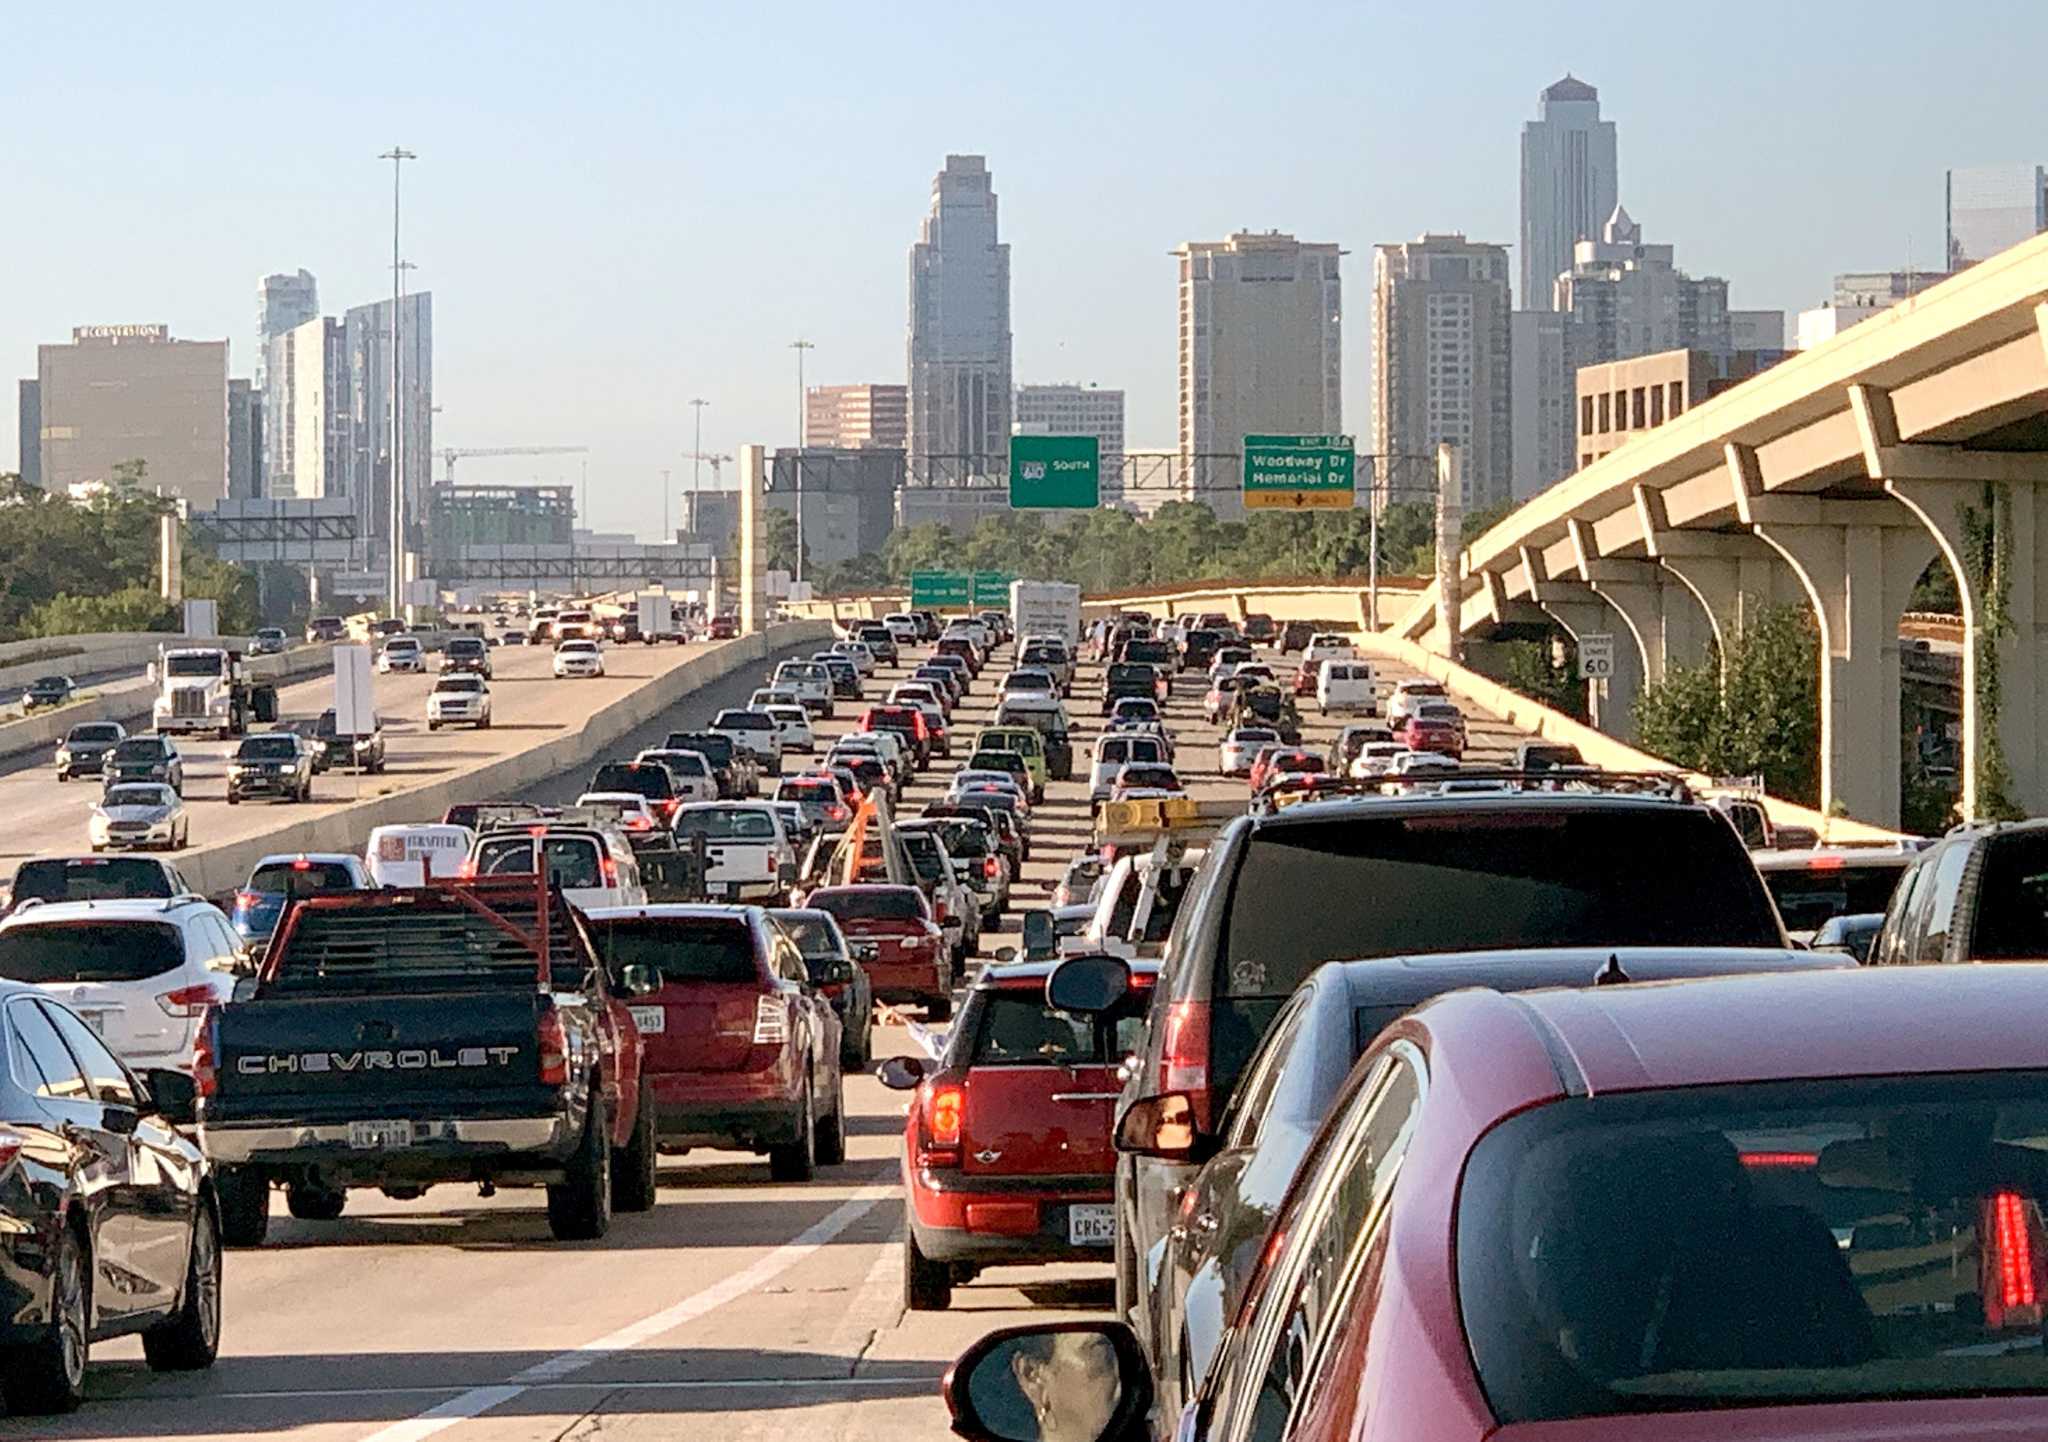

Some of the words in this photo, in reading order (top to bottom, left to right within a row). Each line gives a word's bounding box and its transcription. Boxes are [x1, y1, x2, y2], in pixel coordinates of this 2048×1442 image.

[1052, 460, 1090, 471] SOUTH
[1252, 455, 1324, 470] Woodway
[1329, 455, 1347, 468] Dr
[1252, 471, 1323, 484] Memorial
[1328, 472, 1346, 484] Dr
[1584, 659, 1609, 673] 60
[237, 1046, 519, 1075] CHEVROLET
